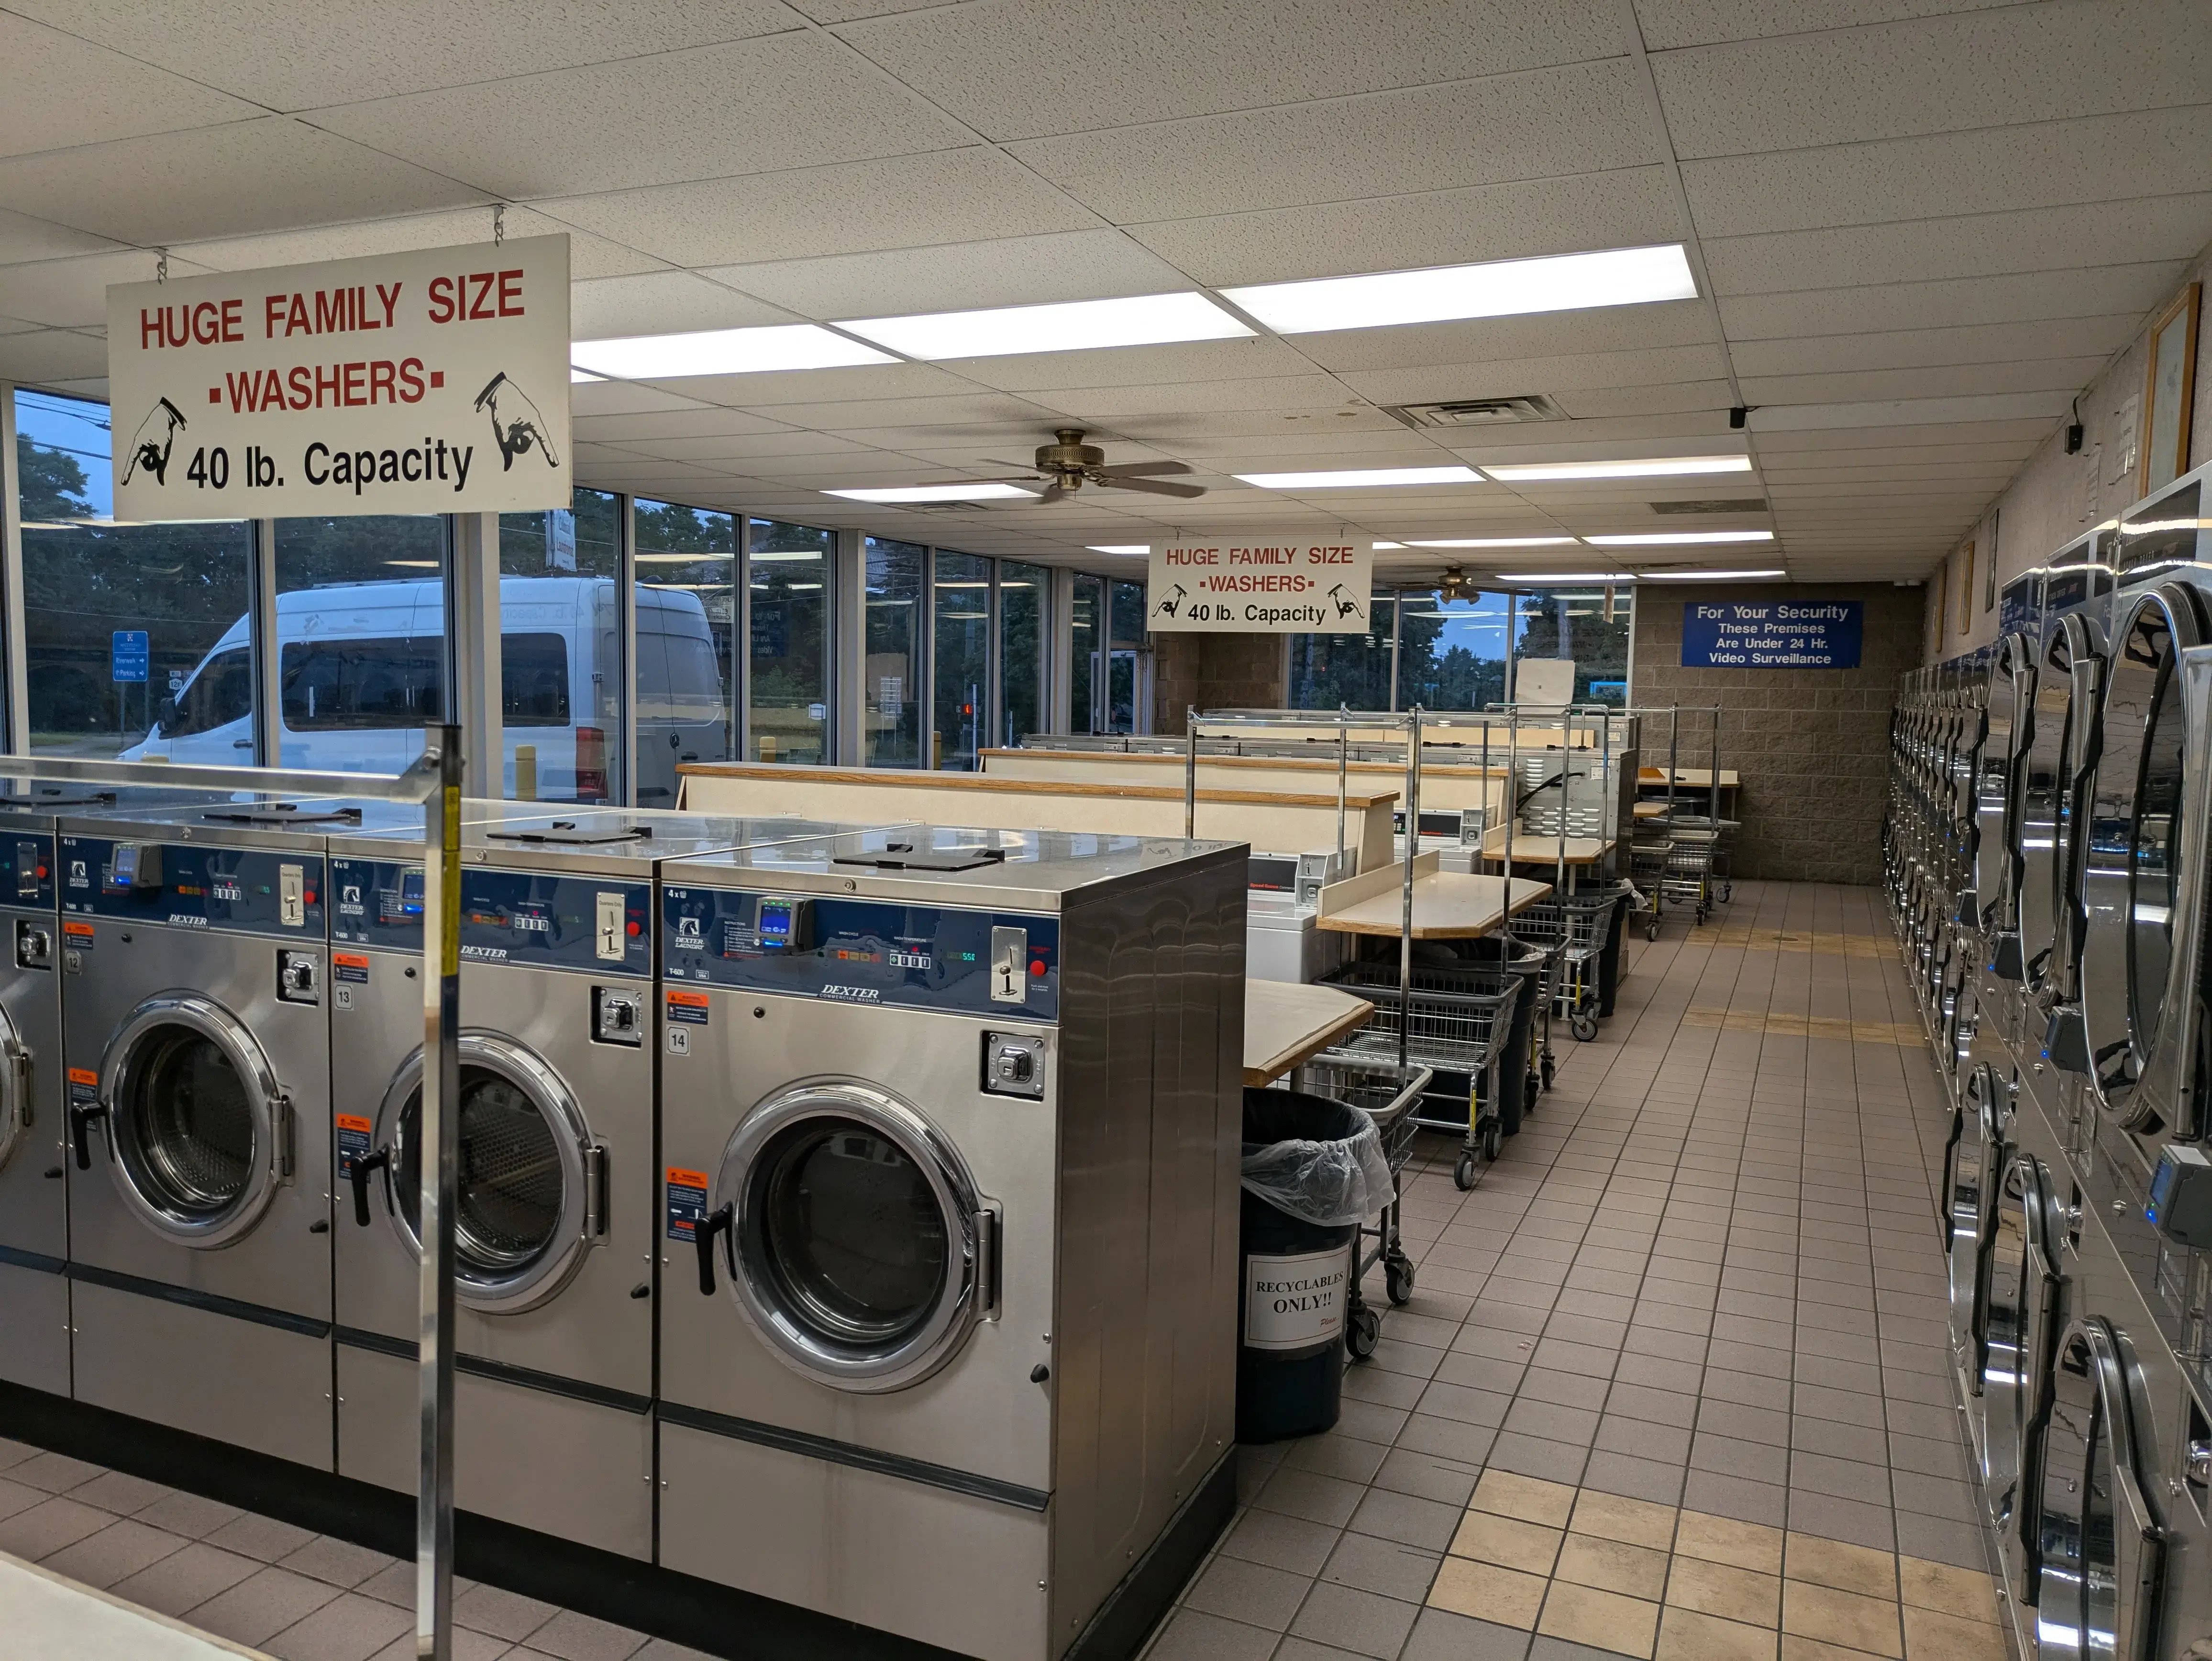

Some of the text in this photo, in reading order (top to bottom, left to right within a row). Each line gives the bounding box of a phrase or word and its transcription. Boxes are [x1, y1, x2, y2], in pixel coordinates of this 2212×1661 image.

[141, 269, 525, 350] HUGE FAMILY SIZE
[225, 357, 425, 414] WASHERS
[187, 437, 474, 496] 40 lb. Capacity
[1166, 547, 1354, 565] HUGE FAMILY SIZE
[1208, 575, 1306, 592] WASHERS
[1188, 604, 1327, 626] 40 lb. Capacity
[1697, 605, 1848, 622] For Your Security
[1718, 623, 1825, 634] These Premises
[1715, 638, 1828, 649] Are Under 24 Hr.
[1709, 653, 1832, 664] Video Surveillance
[334, 861, 339, 869] 4
[668, 889, 674, 897] 4
[169, 914, 208, 925] DEXTER
[675, 937, 704, 945] DEXTER
[460, 945, 507, 958] DEXTER
[69, 956, 78, 968] 12
[669, 968, 685, 976] T-600
[339, 992, 350, 1003] 13
[819, 993, 855, 1001] COMMERCIAL
[821, 985, 879, 998] DEXTER
[672, 1035, 685, 1047] 14
[1256, 1271, 1344, 1293] RECYCLABLES
[1273, 1291, 1332, 1314] ONLY!!
